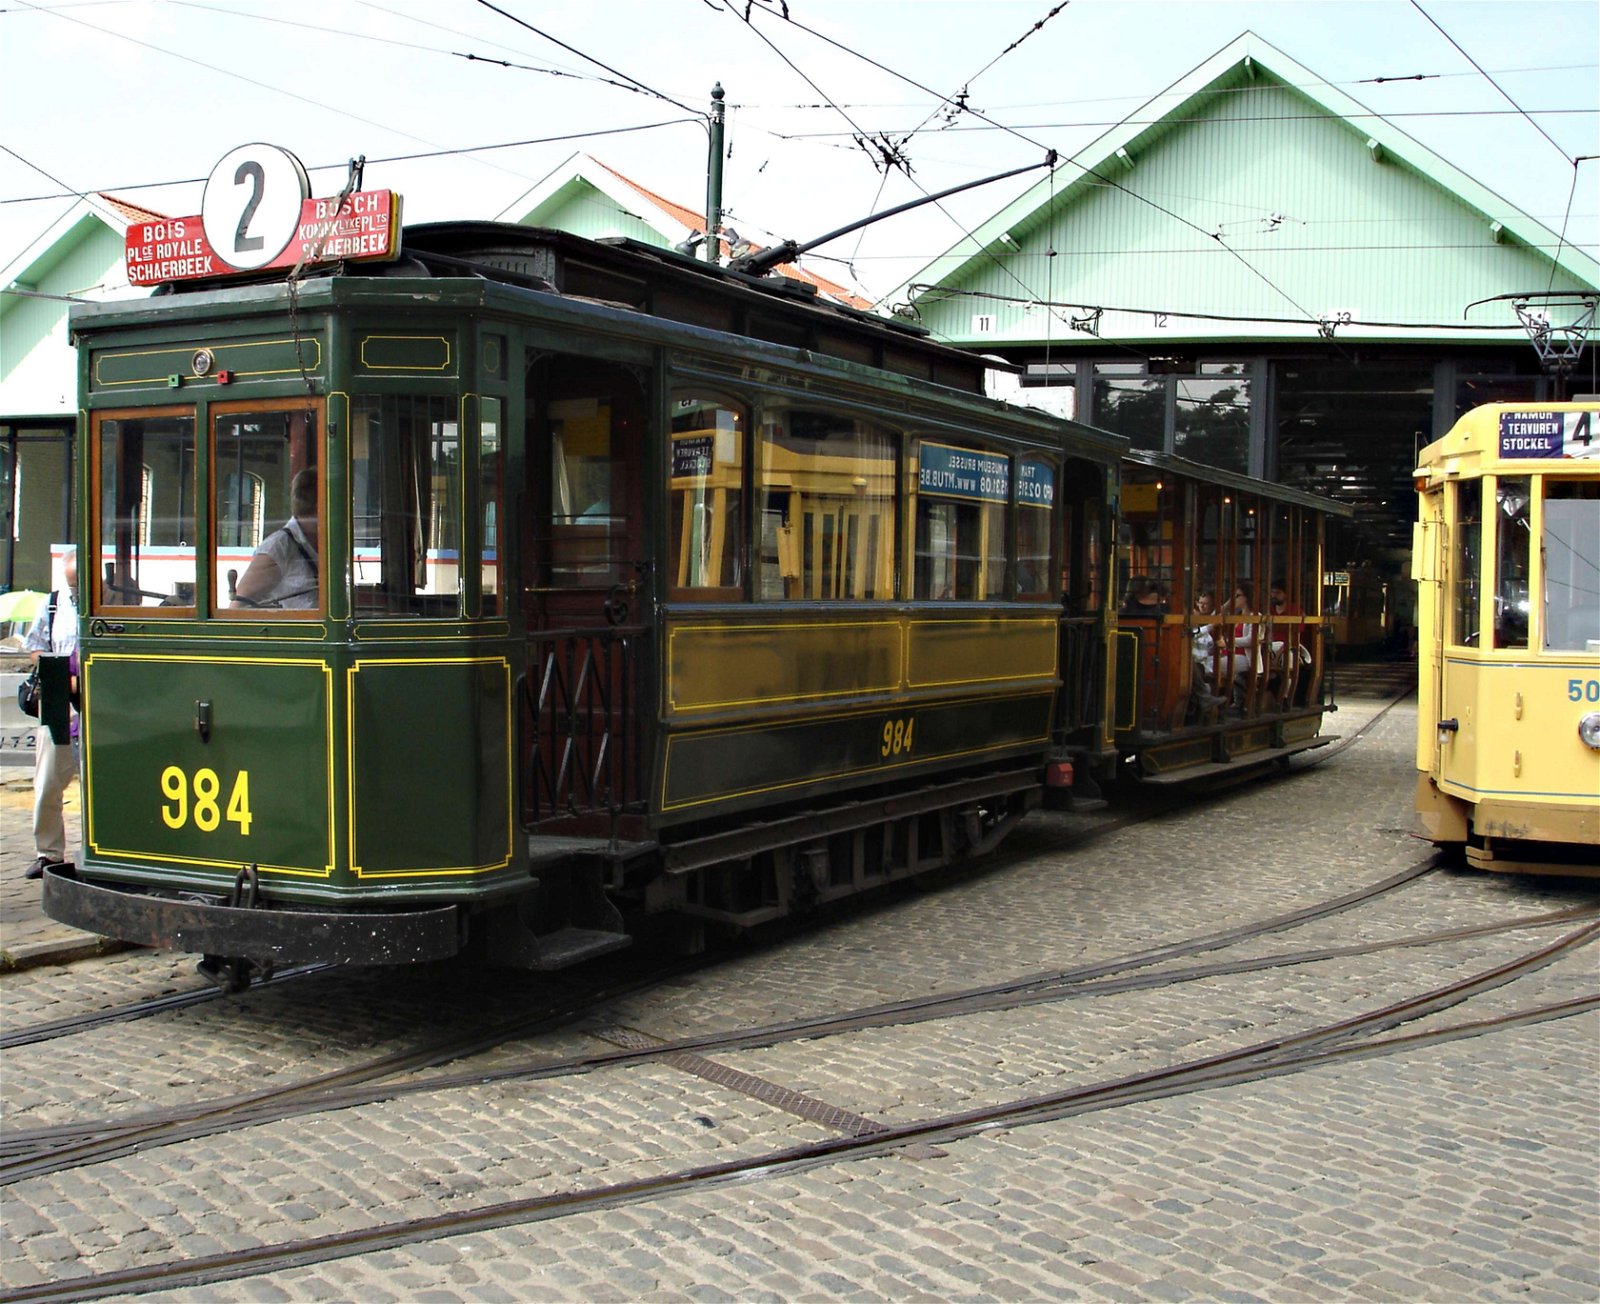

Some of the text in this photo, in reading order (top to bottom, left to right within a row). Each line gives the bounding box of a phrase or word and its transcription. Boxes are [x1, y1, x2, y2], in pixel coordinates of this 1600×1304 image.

[234, 161, 265, 253] 2
[316, 194, 378, 219] BUSCH
[143, 221, 185, 243] BOIS
[156, 238, 203, 260] ROYALE
[128, 255, 213, 282] SCHAERBEEK
[979, 317, 989, 331] 11
[1154, 311, 1167, 328] 12
[1508, 422, 1558, 435] TERVUREN
[1572, 411, 1593, 446] 4
[1503, 438, 1552, 450] STOCKEL
[1567, 679, 1600, 702] 50
[882, 717, 914, 757] 984
[160, 765, 253, 836] 984
